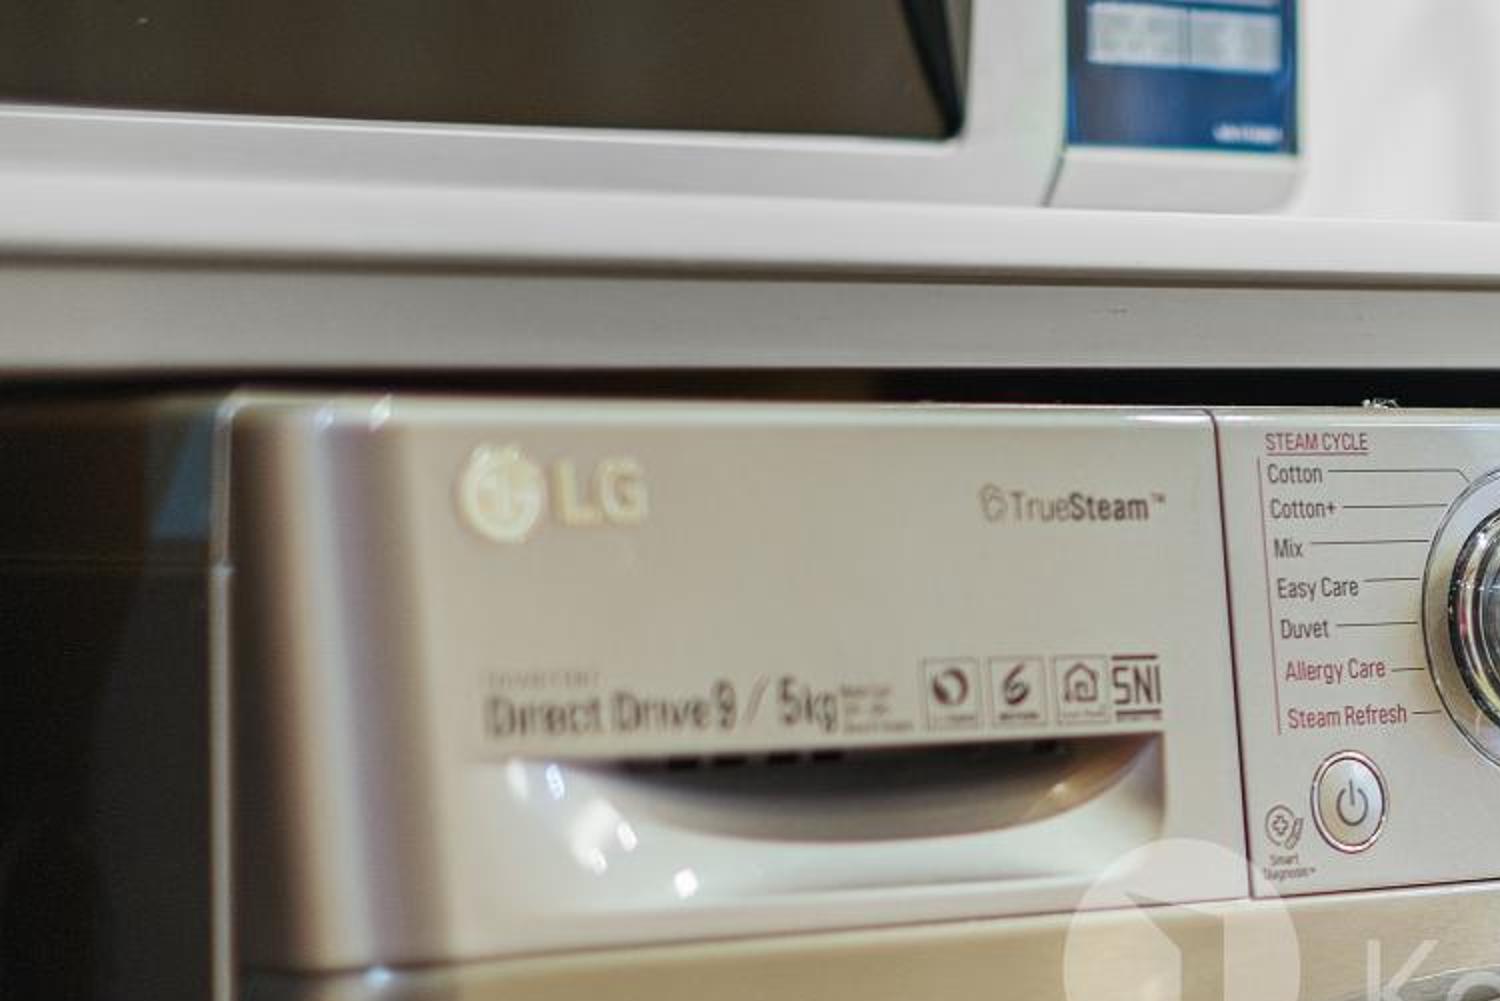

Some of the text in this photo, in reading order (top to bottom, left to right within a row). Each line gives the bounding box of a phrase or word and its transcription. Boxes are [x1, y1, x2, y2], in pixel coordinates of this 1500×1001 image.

[1265, 432, 1368, 451] STEAM CYCLE
[1267, 463, 1323, 484] Cotton
[553, 456, 650, 526] LG
[1270, 498, 1337, 519] Cotton+
[1274, 538, 1304, 559] Mix
[1277, 576, 1360, 602] Easy Care
[1280, 618, 1330, 640] Duvet
[1286, 657, 1387, 685] Allergy Care
[1112, 664, 1162, 706] SNI
[484, 697, 604, 738] Direct
[611, 691, 710, 732] Drive
[1287, 703, 1408, 730] Steam Refresh
